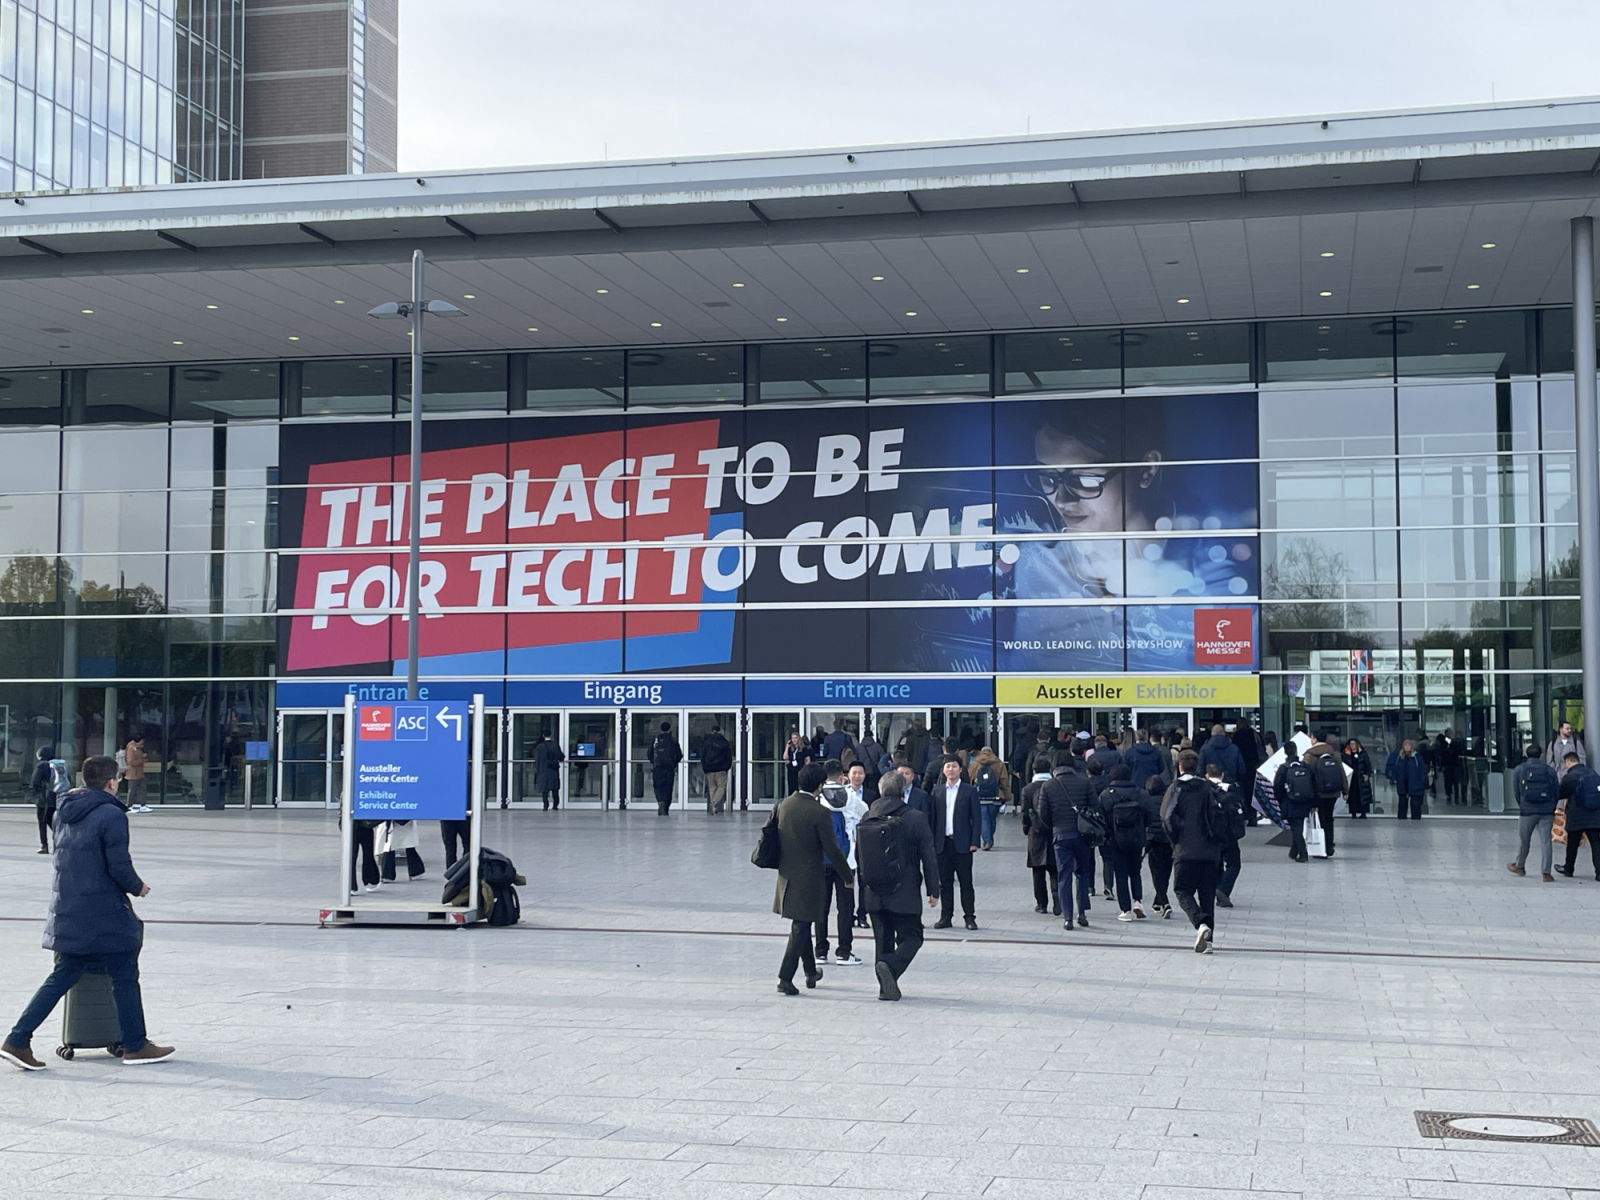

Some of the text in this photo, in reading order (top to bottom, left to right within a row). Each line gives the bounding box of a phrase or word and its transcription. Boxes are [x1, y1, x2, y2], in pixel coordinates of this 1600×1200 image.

[320, 427, 905, 548] THE PLACE TO BE
[312, 503, 1021, 630] FOR TECH TO COME.
[1003, 639, 1187, 650] WORLD. LEADING. INDUSTRYSHOW.
[1196, 640, 1251, 649] HANNOVER
[1206, 647, 1242, 655] MESSE
[348, 684, 430, 701] Entrane
[584, 681, 662, 704] Eingang
[822, 681, 911, 699] Entrance
[1036, 682, 1217, 700] Aussteller Exhibitor
[397, 716, 426, 730] ASC
[359, 763, 402, 773] Aussteller
[359, 773, 419, 783] Service Center
[359, 790, 398, 800] Exhibitor
[358, 800, 418, 810] Service Center
